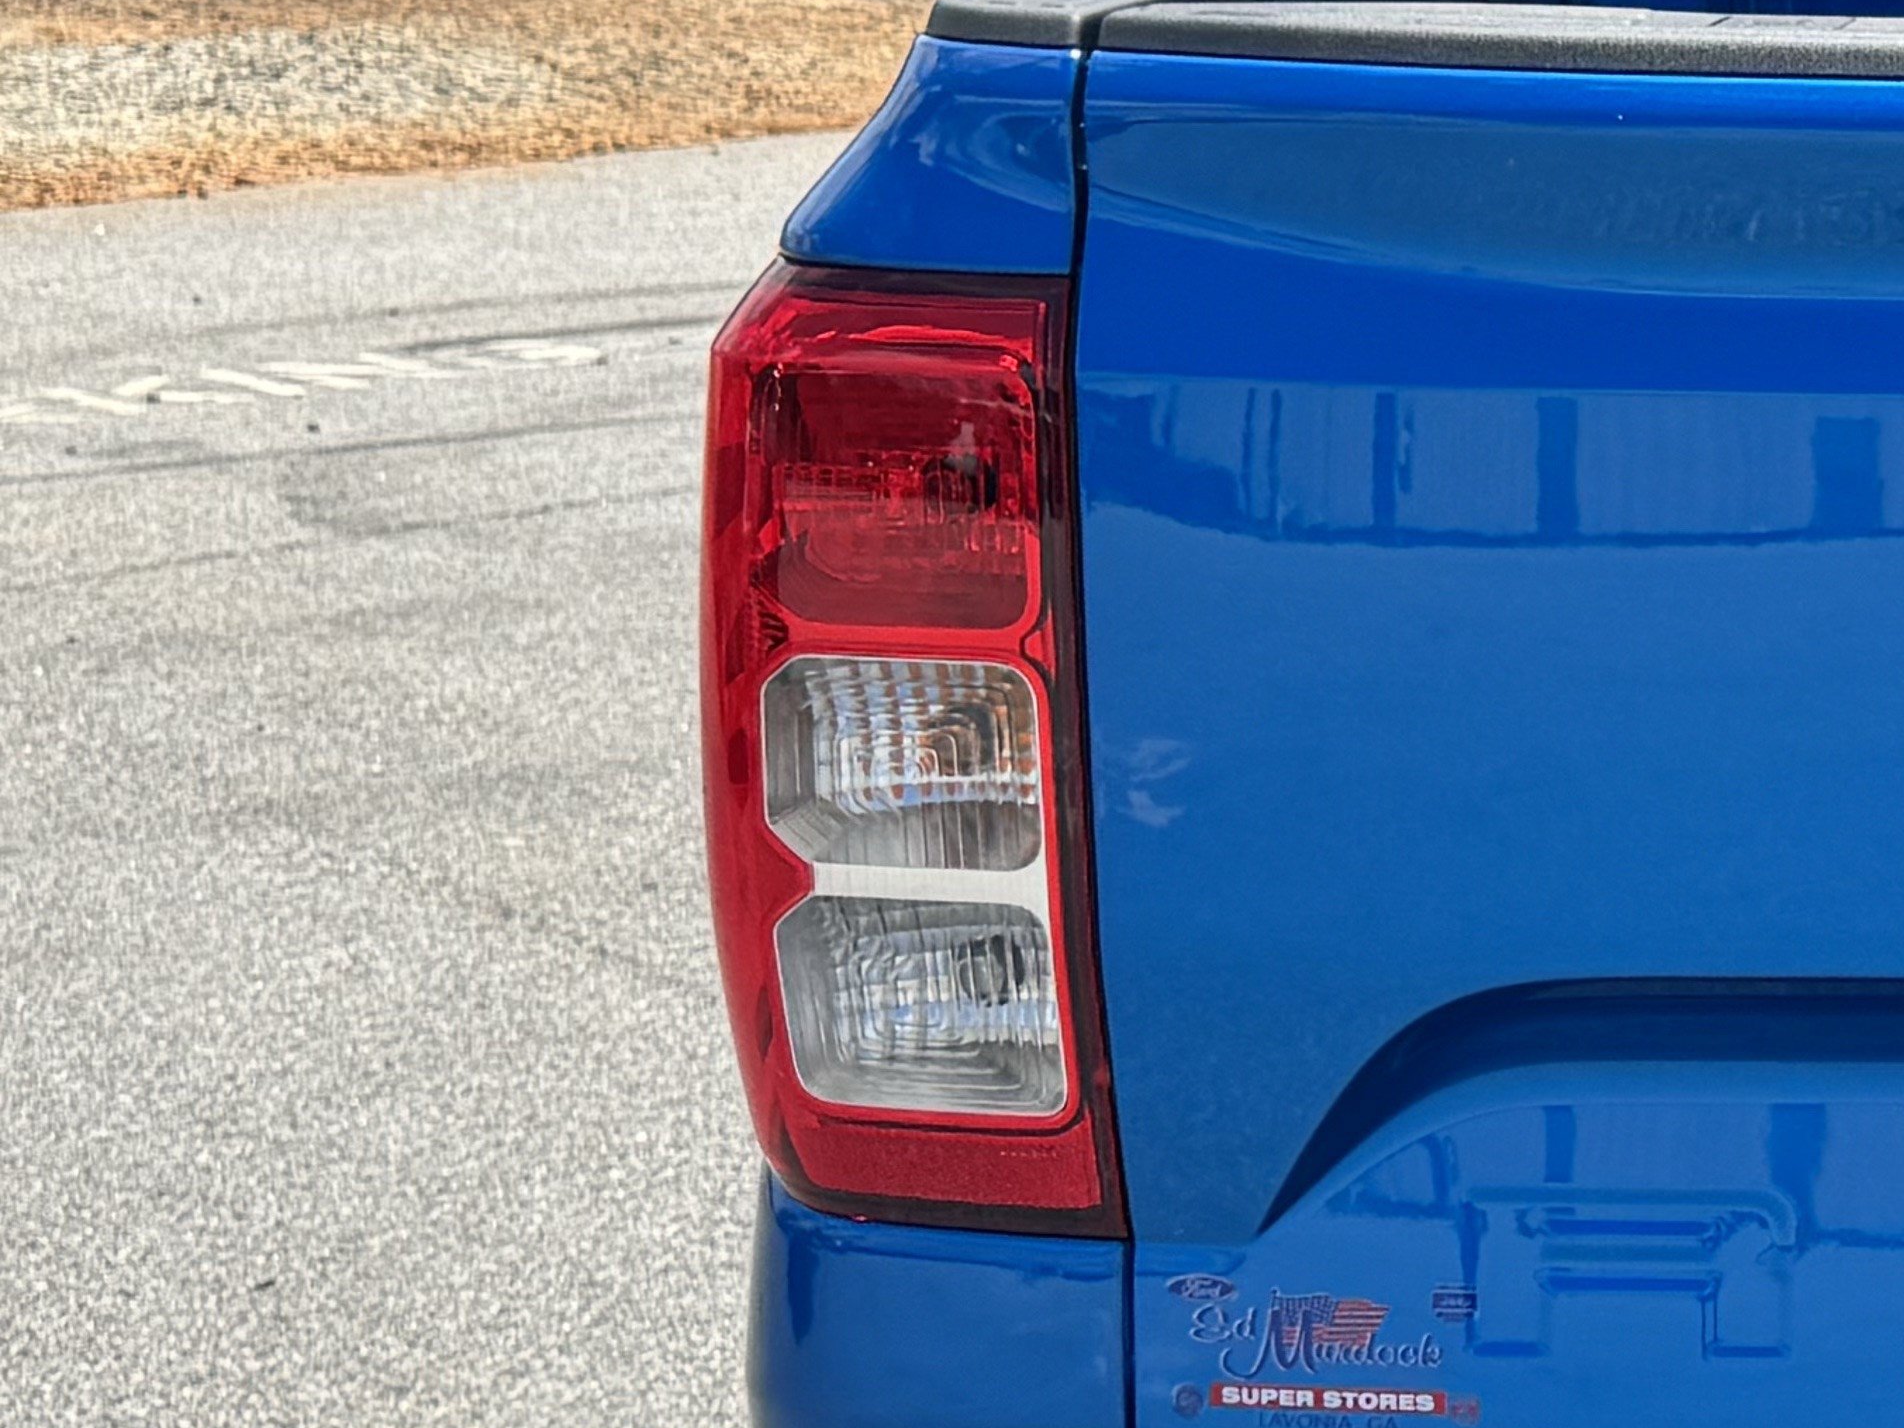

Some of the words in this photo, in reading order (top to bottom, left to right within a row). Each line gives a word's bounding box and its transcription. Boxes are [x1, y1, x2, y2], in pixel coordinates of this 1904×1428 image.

[1189, 1302, 1257, 1344] Ed
[1219, 1304, 1444, 1380] Murdock
[1221, 1385, 1314, 1408] SUPER
[1322, 1390, 1436, 1412] STORES
